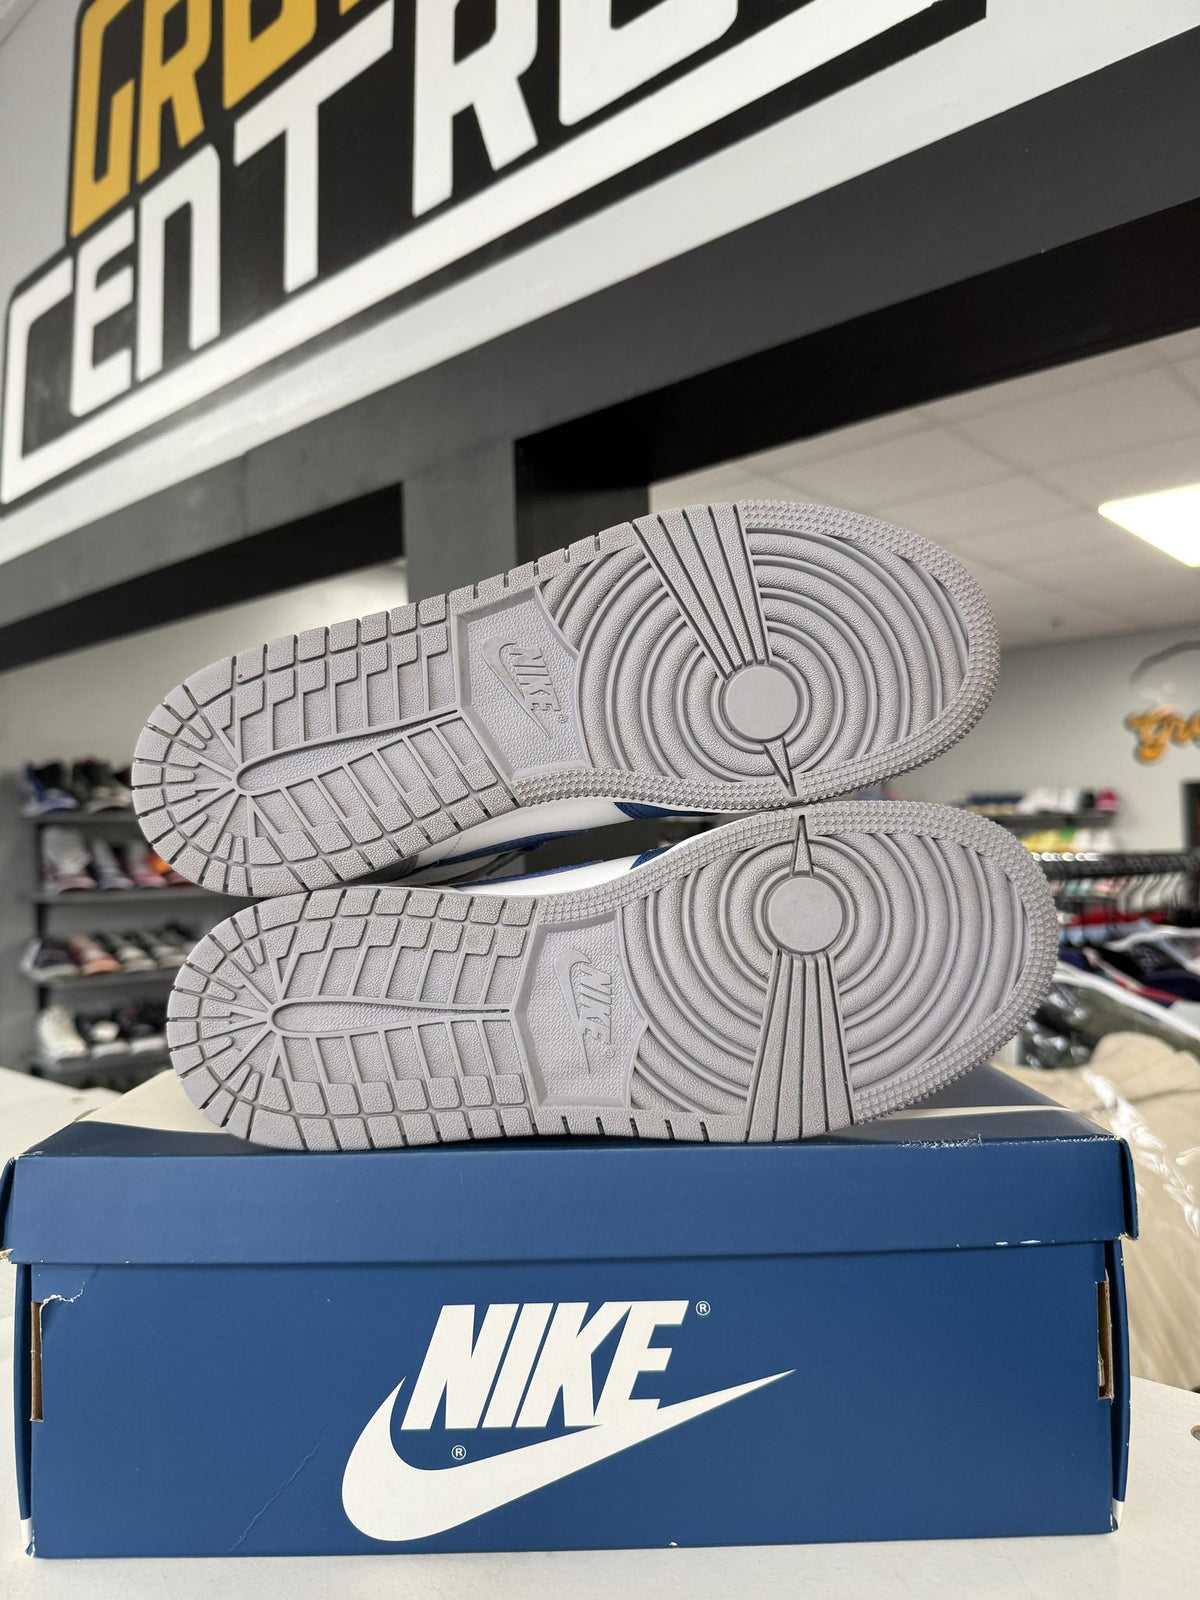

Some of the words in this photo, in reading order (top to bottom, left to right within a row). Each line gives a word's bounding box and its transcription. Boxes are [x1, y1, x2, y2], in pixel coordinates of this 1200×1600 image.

[508, 647, 562, 713] NIKE
[578, 963, 613, 1045] NIKE
[400, 1299, 690, 1430] NIKE
